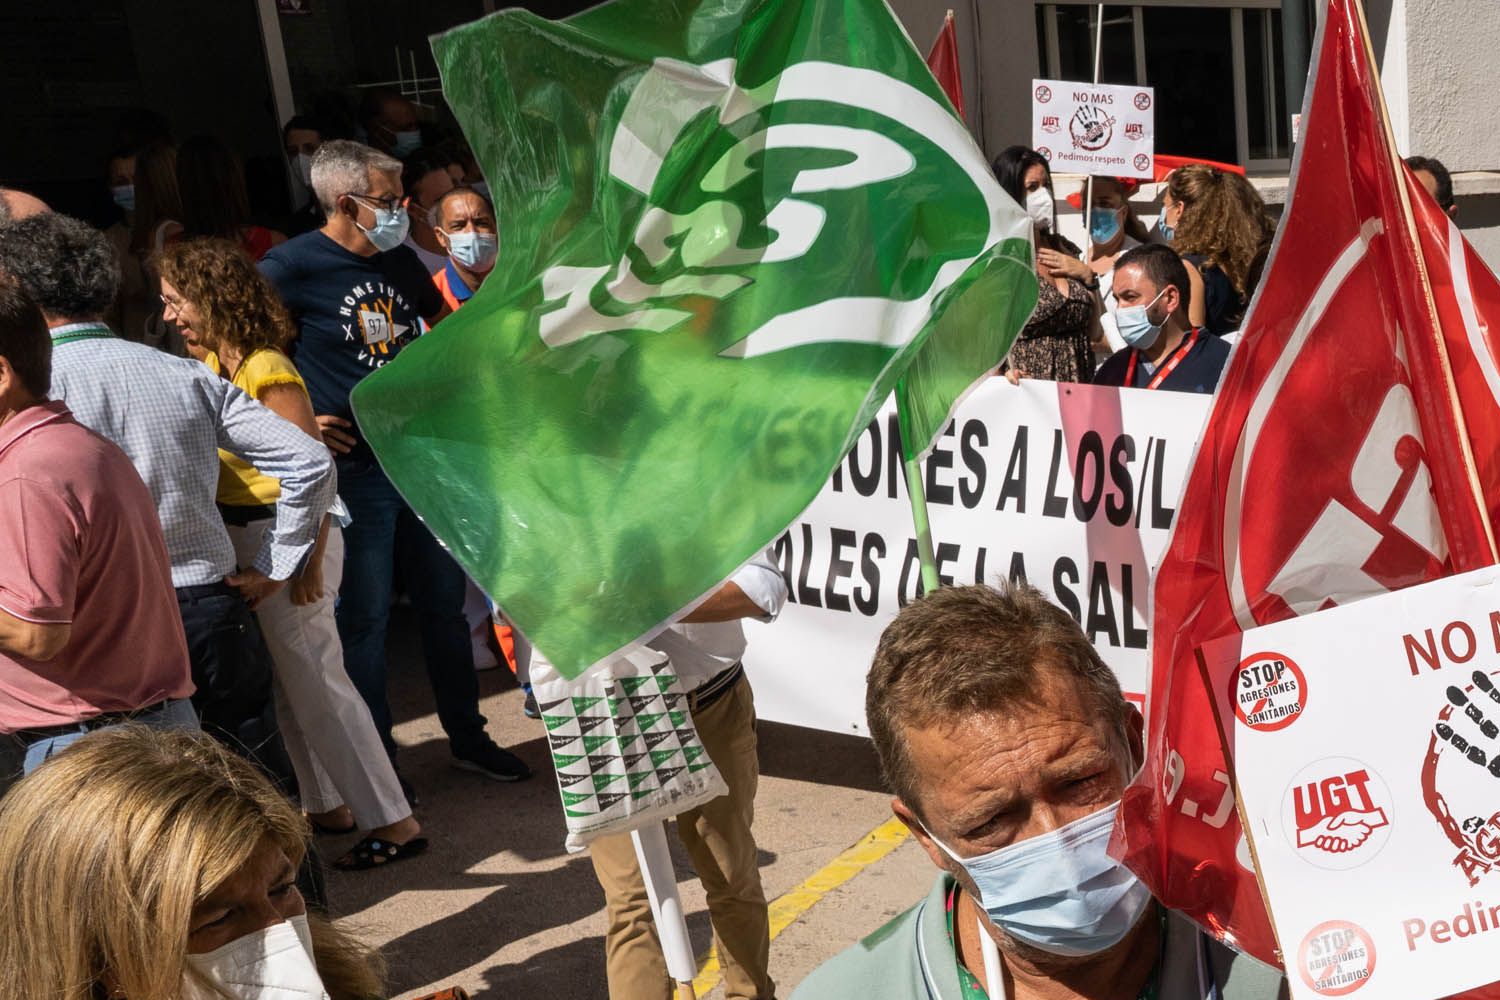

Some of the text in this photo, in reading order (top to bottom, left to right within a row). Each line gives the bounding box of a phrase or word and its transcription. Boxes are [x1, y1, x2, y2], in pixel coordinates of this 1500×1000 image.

[1072, 92, 1114, 105] NO MAS
[1041, 115, 1060, 127] UGT
[1125, 122, 1143, 134] UGT
[1058, 151, 1094, 162] Pedimos
[1095, 154, 1126, 167] respeto
[995, 424, 1029, 514] A
[1041, 428, 1176, 530] LOS/L
[1402, 620, 1478, 676] NO
[1240, 660, 1286, 689] STOP
[1239, 680, 1297, 704] AGRESIONES
[1246, 702, 1301, 725] SANITARIOS
[1293, 769, 1375, 830] UGT
[1309, 928, 1355, 957] STOP
[1308, 947, 1366, 971] AGRESIONES
[1314, 968, 1369, 991] SANITARIOS
